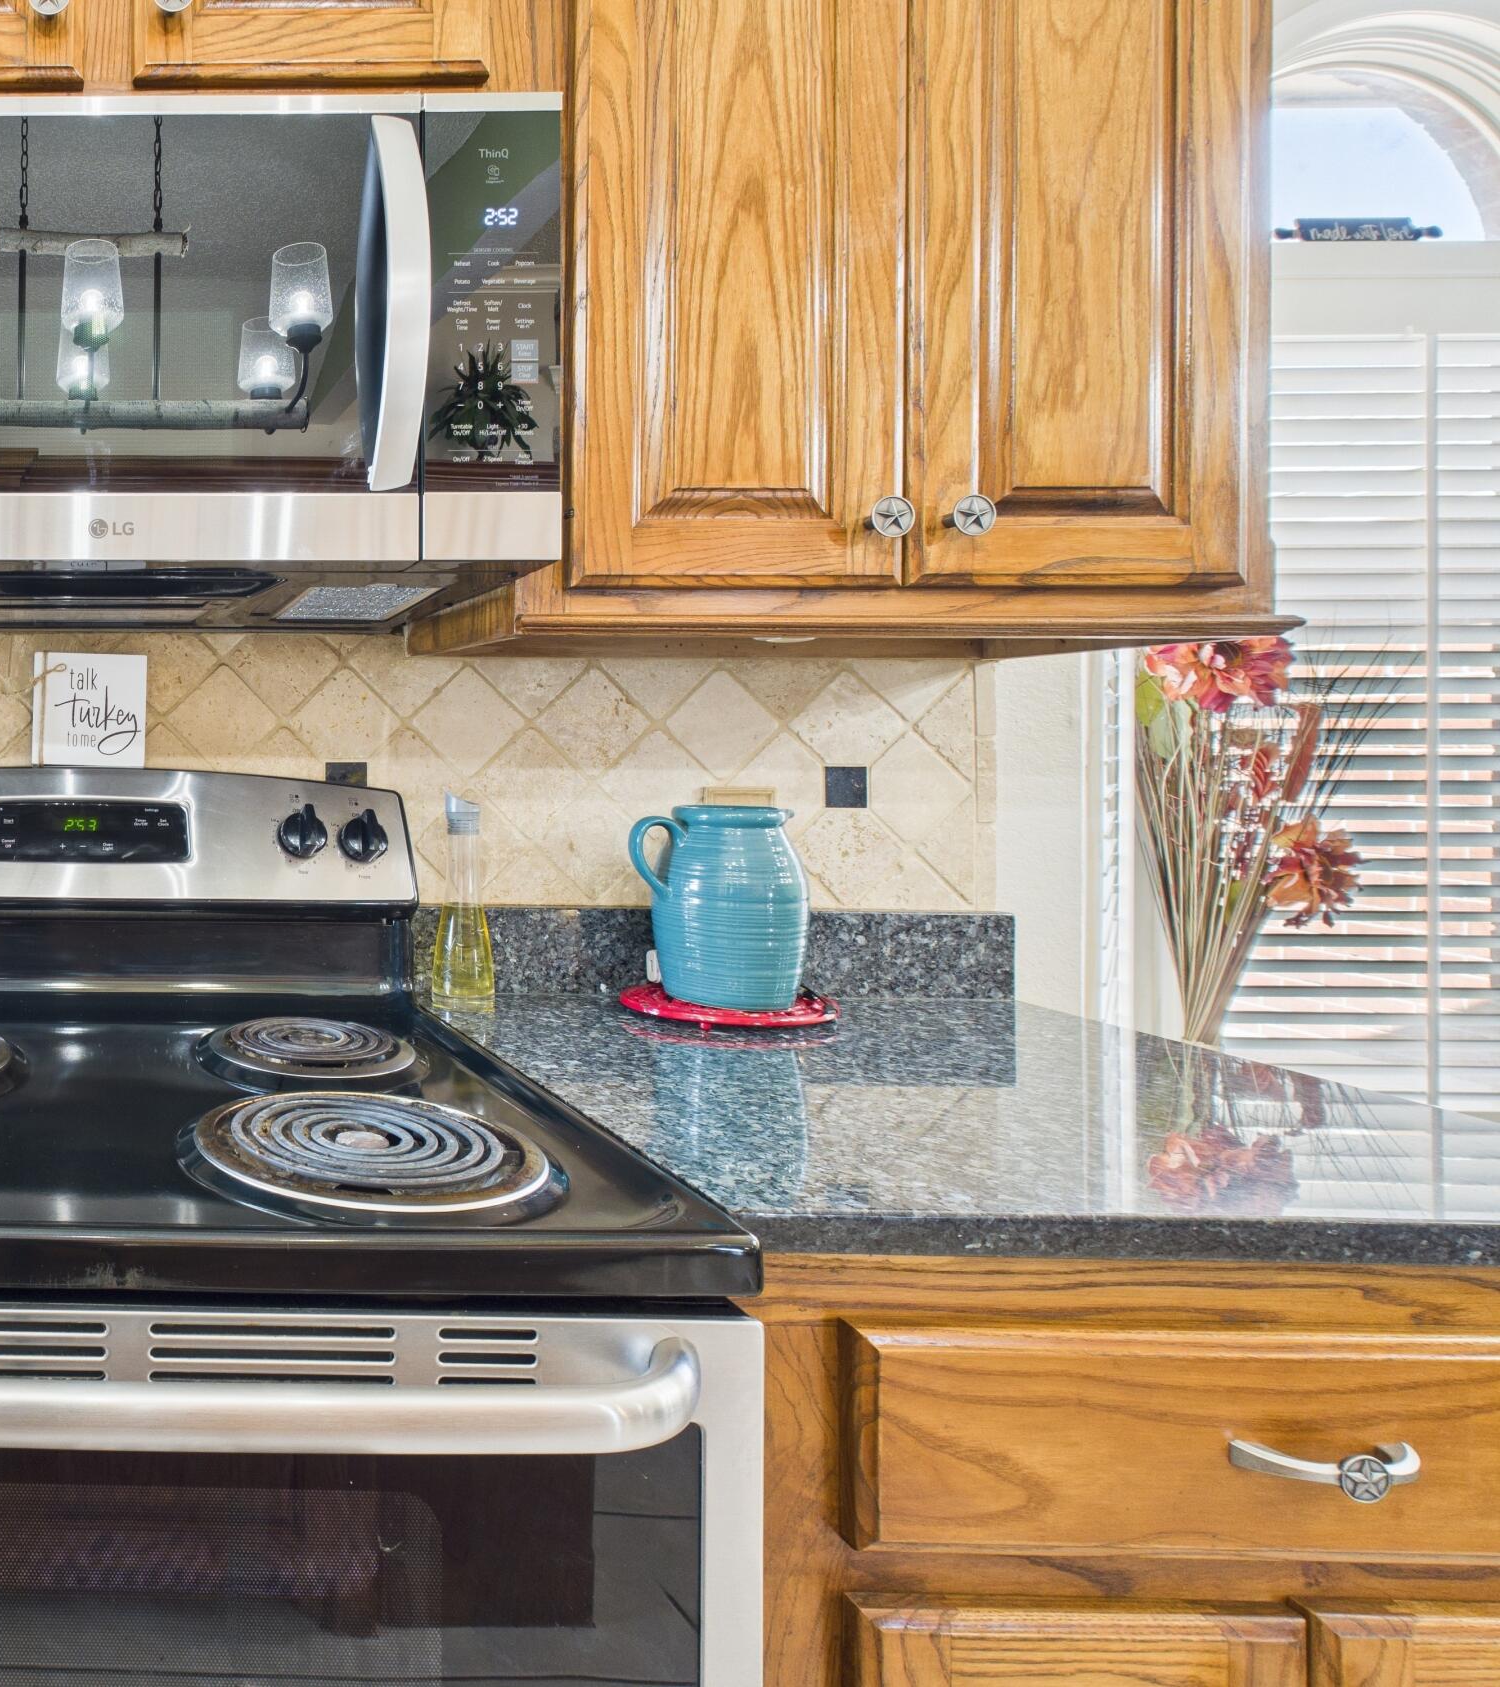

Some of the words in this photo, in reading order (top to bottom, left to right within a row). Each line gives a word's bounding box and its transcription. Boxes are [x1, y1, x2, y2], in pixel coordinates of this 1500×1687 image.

[478, 148, 509, 160] ThinQ
[484, 208, 518, 226] 2:52
[1309, 222, 1351, 241] made
[459, 344, 463, 352] 1
[478, 344, 484, 352] 2
[497, 344, 504, 352] 3
[458, 362, 464, 370] 4
[478, 362, 484, 370] 5
[497, 362, 503, 370] 6
[458, 382, 464, 390] 7
[478, 382, 484, 390] 8
[497, 382, 503, 390] 9
[478, 401, 484, 410] 0
[70, 667, 98, 690] talk
[54, 685, 142, 756] turkey
[67, 731, 78, 747] to
[80, 734, 97, 748] me
